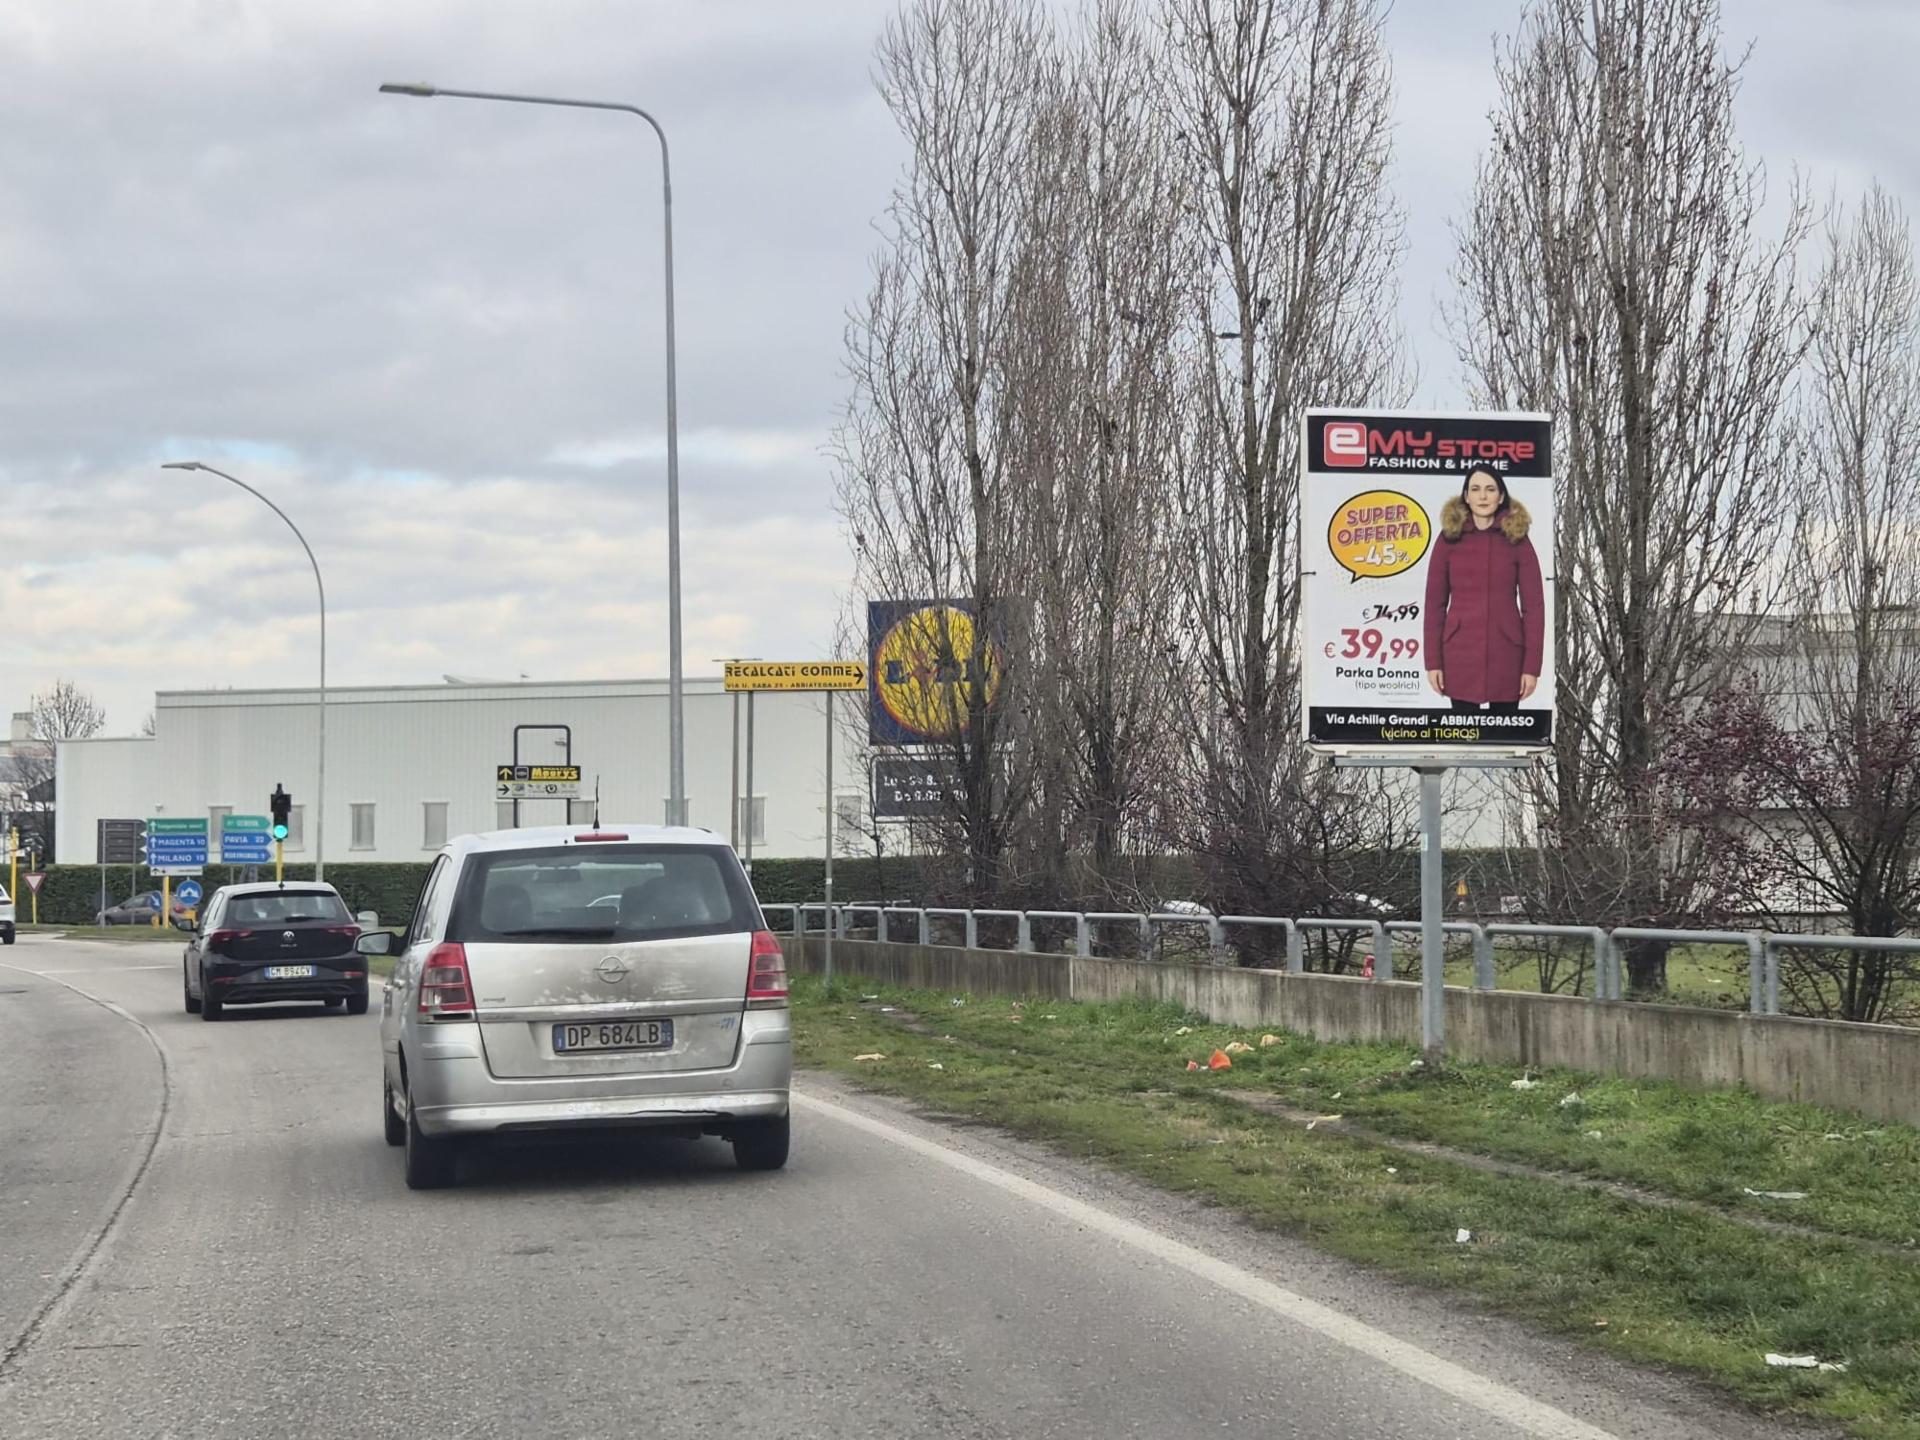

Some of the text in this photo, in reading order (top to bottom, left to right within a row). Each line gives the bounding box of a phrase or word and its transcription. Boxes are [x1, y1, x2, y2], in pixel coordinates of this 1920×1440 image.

[1369, 430, 1432, 456] MY
[1369, 457, 1440, 470] FASHION
[1444, 460, 1456, 470] &
[1346, 504, 1408, 526] SUPER
[1337, 521, 1422, 546] OFFERTA
[1341, 628, 1420, 664] 39,99
[801, 666, 853, 677] GOMME
[1336, 666, 1420, 679] Parka Donna
[1355, 680, 1420, 690] (tipo woolrich)
[1326, 714, 1345, 725] Via
[1349, 714, 1386, 725] Achille
[1388, 714, 1429, 726] Grandi
[1440, 715, 1535, 727] ABBIATEGRASSO
[1381, 727, 1418, 741] (vicino
[1420, 728, 1431, 738] al
[158, 854, 192, 862] MILANO
[568, 1027, 591, 1046] DP
[600, 1024, 659, 1045] 684LB
